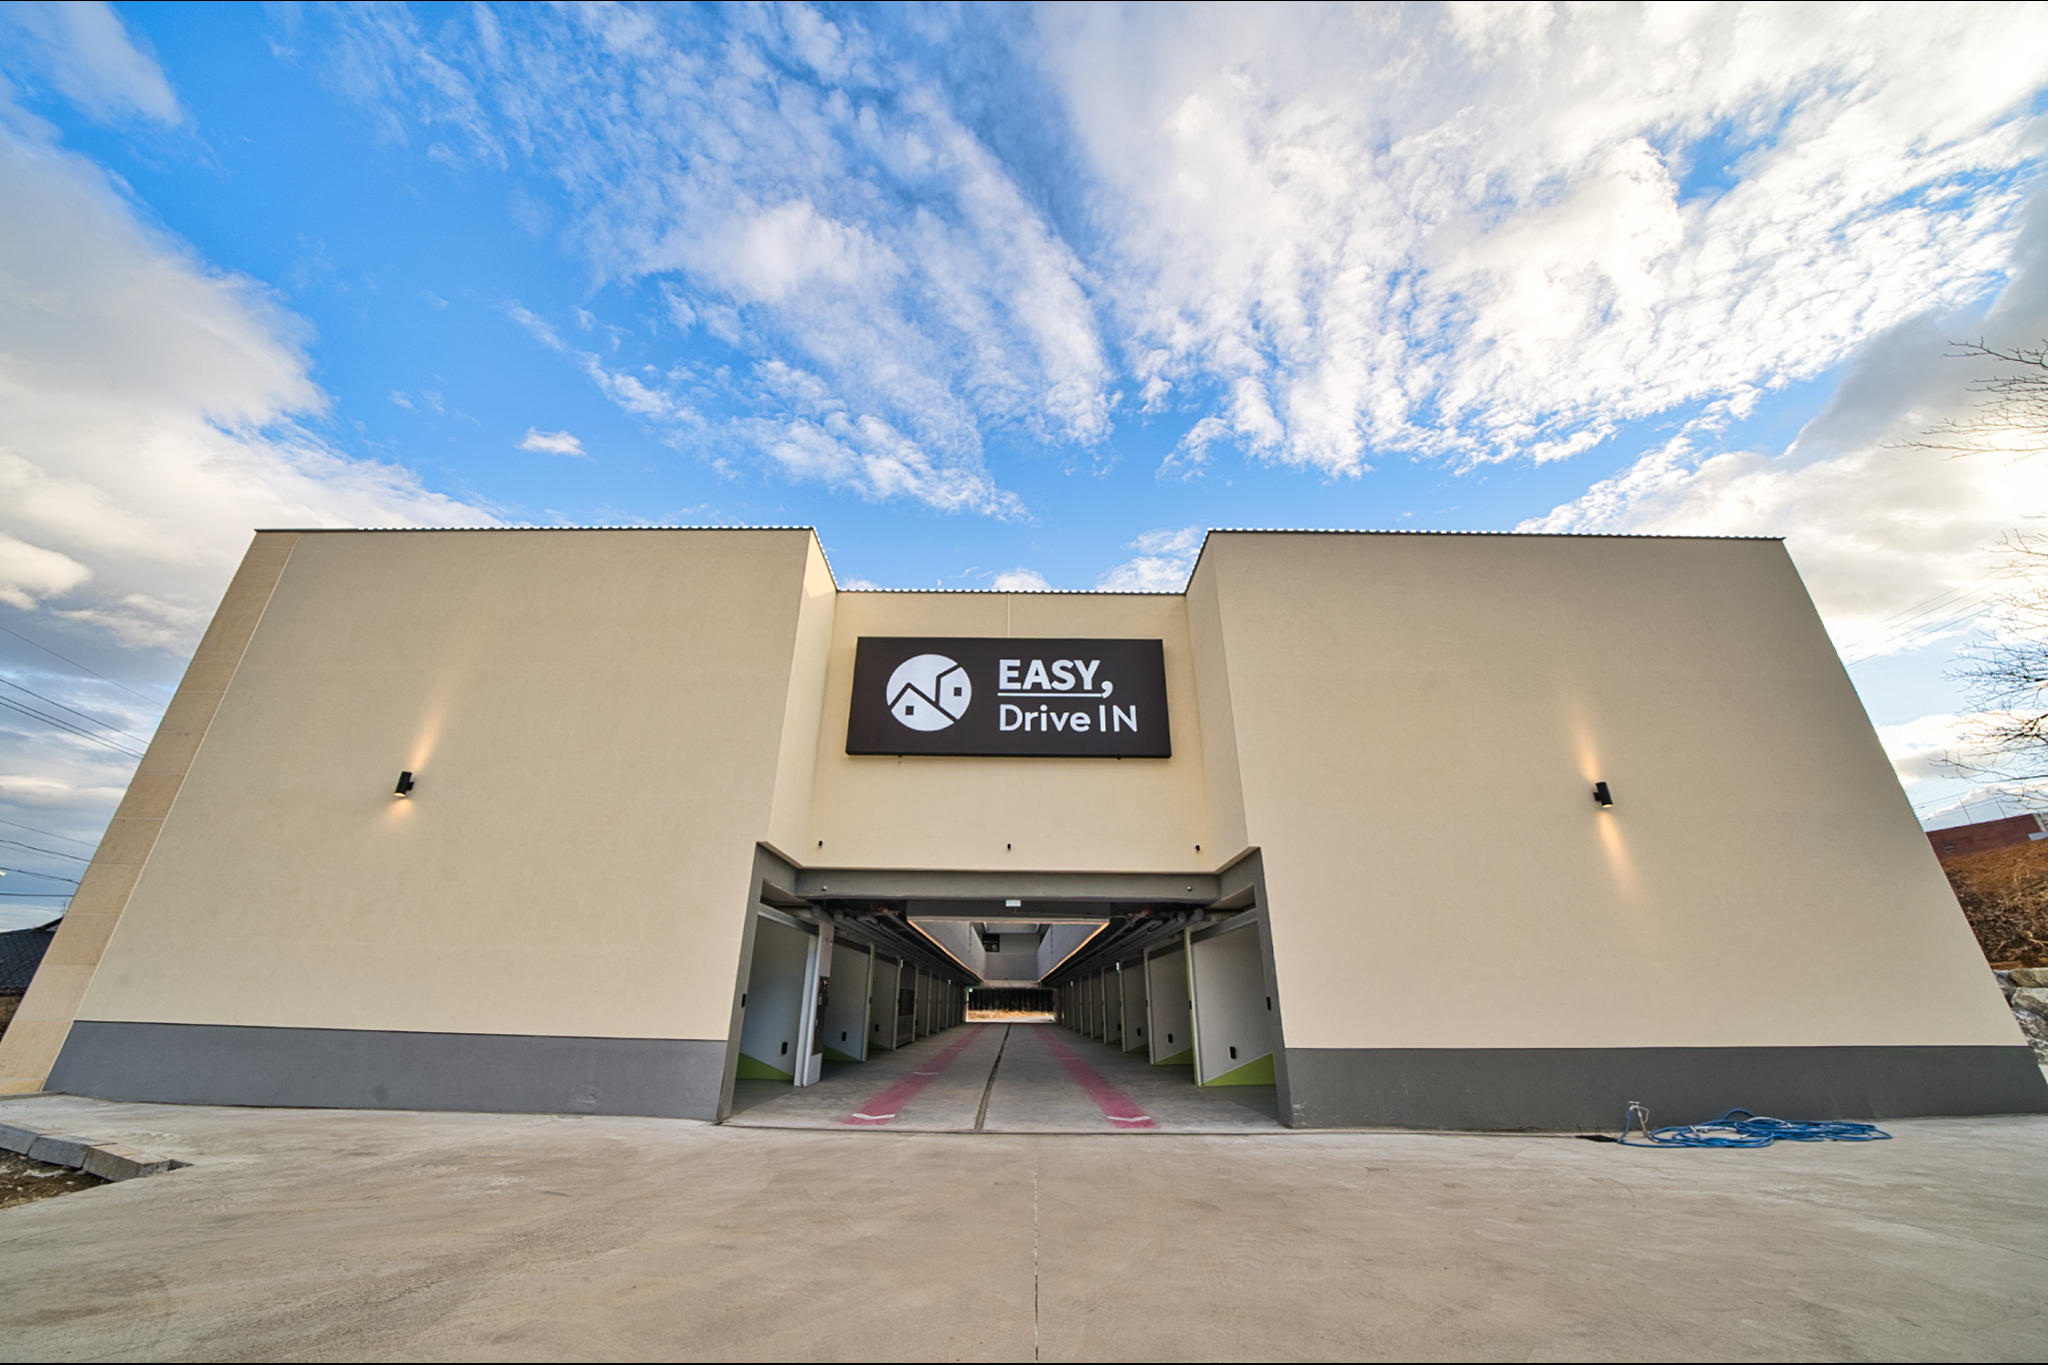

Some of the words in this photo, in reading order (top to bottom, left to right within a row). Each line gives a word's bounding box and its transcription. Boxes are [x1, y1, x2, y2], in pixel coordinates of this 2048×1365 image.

[998, 659, 1114, 699] EASY,
[998, 703, 1091, 732] Drive
[1098, 704, 1138, 733] IN
